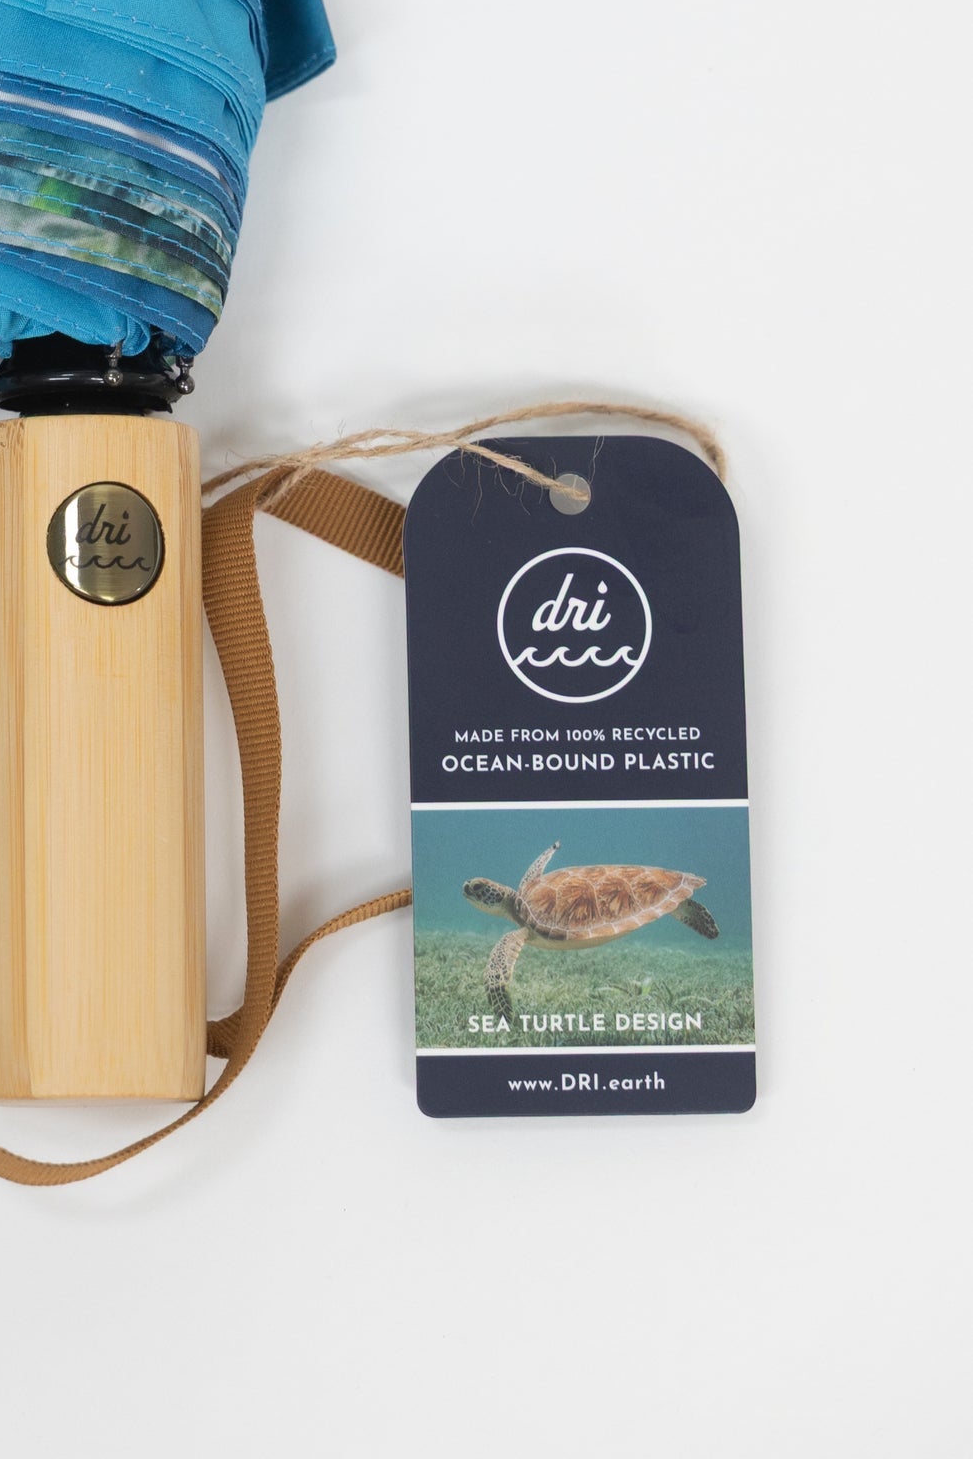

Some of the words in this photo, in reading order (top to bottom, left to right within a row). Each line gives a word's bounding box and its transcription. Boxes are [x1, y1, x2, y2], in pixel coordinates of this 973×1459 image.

[75, 503, 131, 545] dri
[532, 573, 611, 632] dri
[455, 729, 504, 743] MADE
[511, 729, 559, 742] FROM
[566, 728, 606, 742] 100%
[612, 727, 701, 741] RECYCLED
[441, 753, 615, 772] OCEAN-BOUND
[625, 752, 715, 771] PLASTIC
[468, 1015, 510, 1033] SEA
[519, 1014, 605, 1032] TURTLE
[615, 1013, 702, 1031] DESIGN
[508, 1071, 666, 1091] www.DRI.earth
